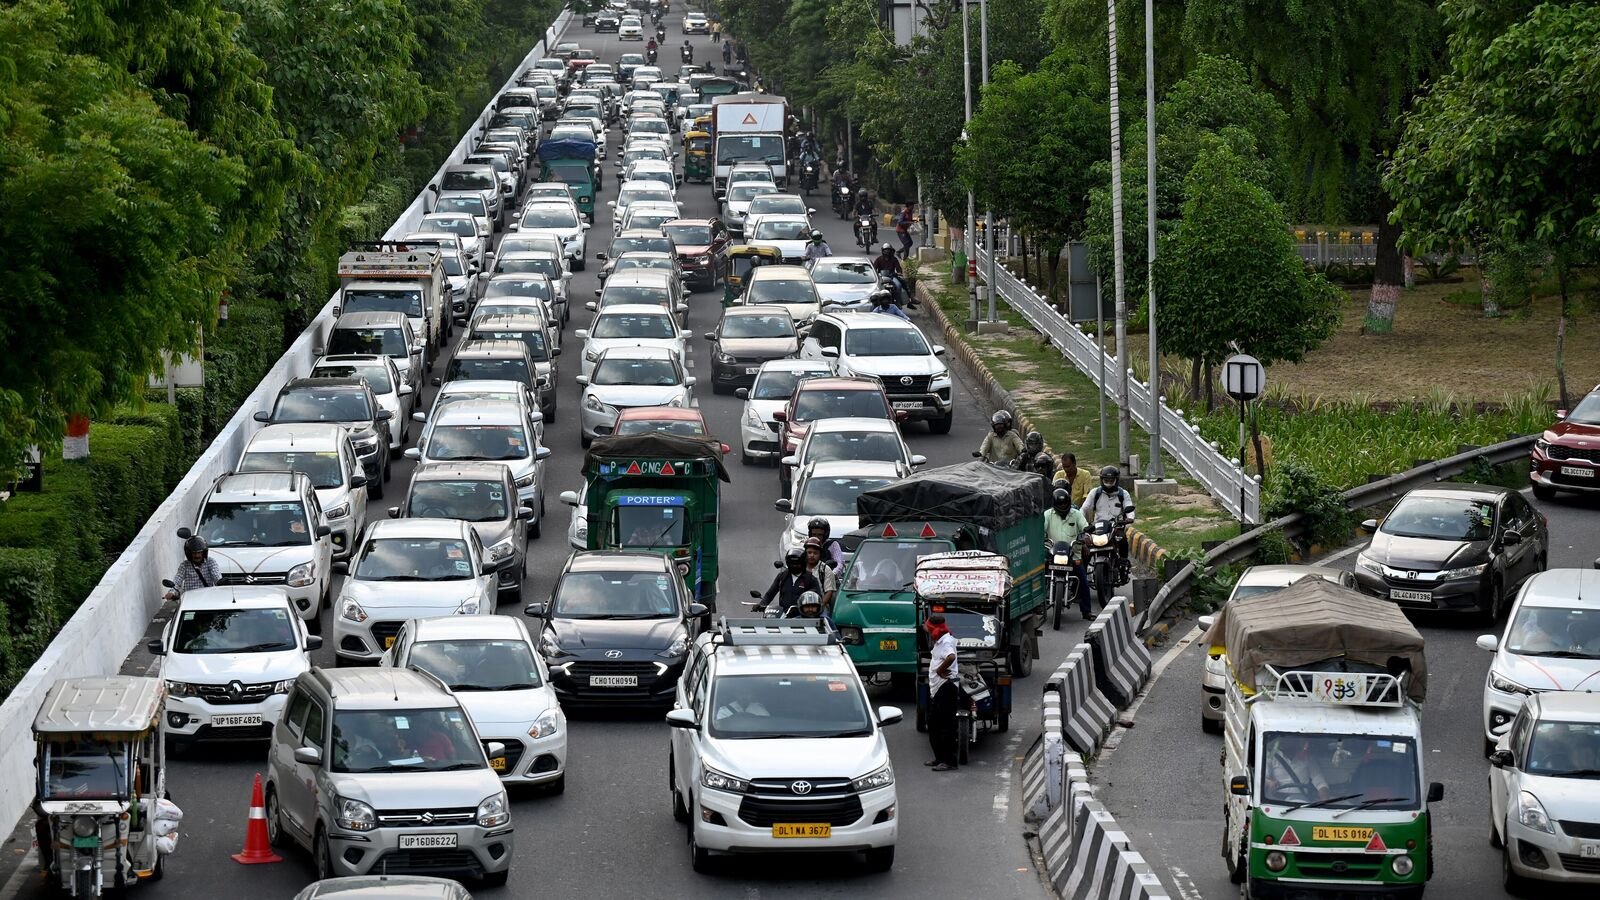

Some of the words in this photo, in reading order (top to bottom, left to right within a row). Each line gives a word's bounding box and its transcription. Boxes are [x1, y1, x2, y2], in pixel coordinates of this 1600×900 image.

[641, 462, 661, 474] CNG
[628, 496, 671, 504] PORTER
[594, 676, 638, 685] CH01CH0994
[216, 715, 262, 726] UP16BF4826
[404, 836, 456, 847] UP16DB6224
